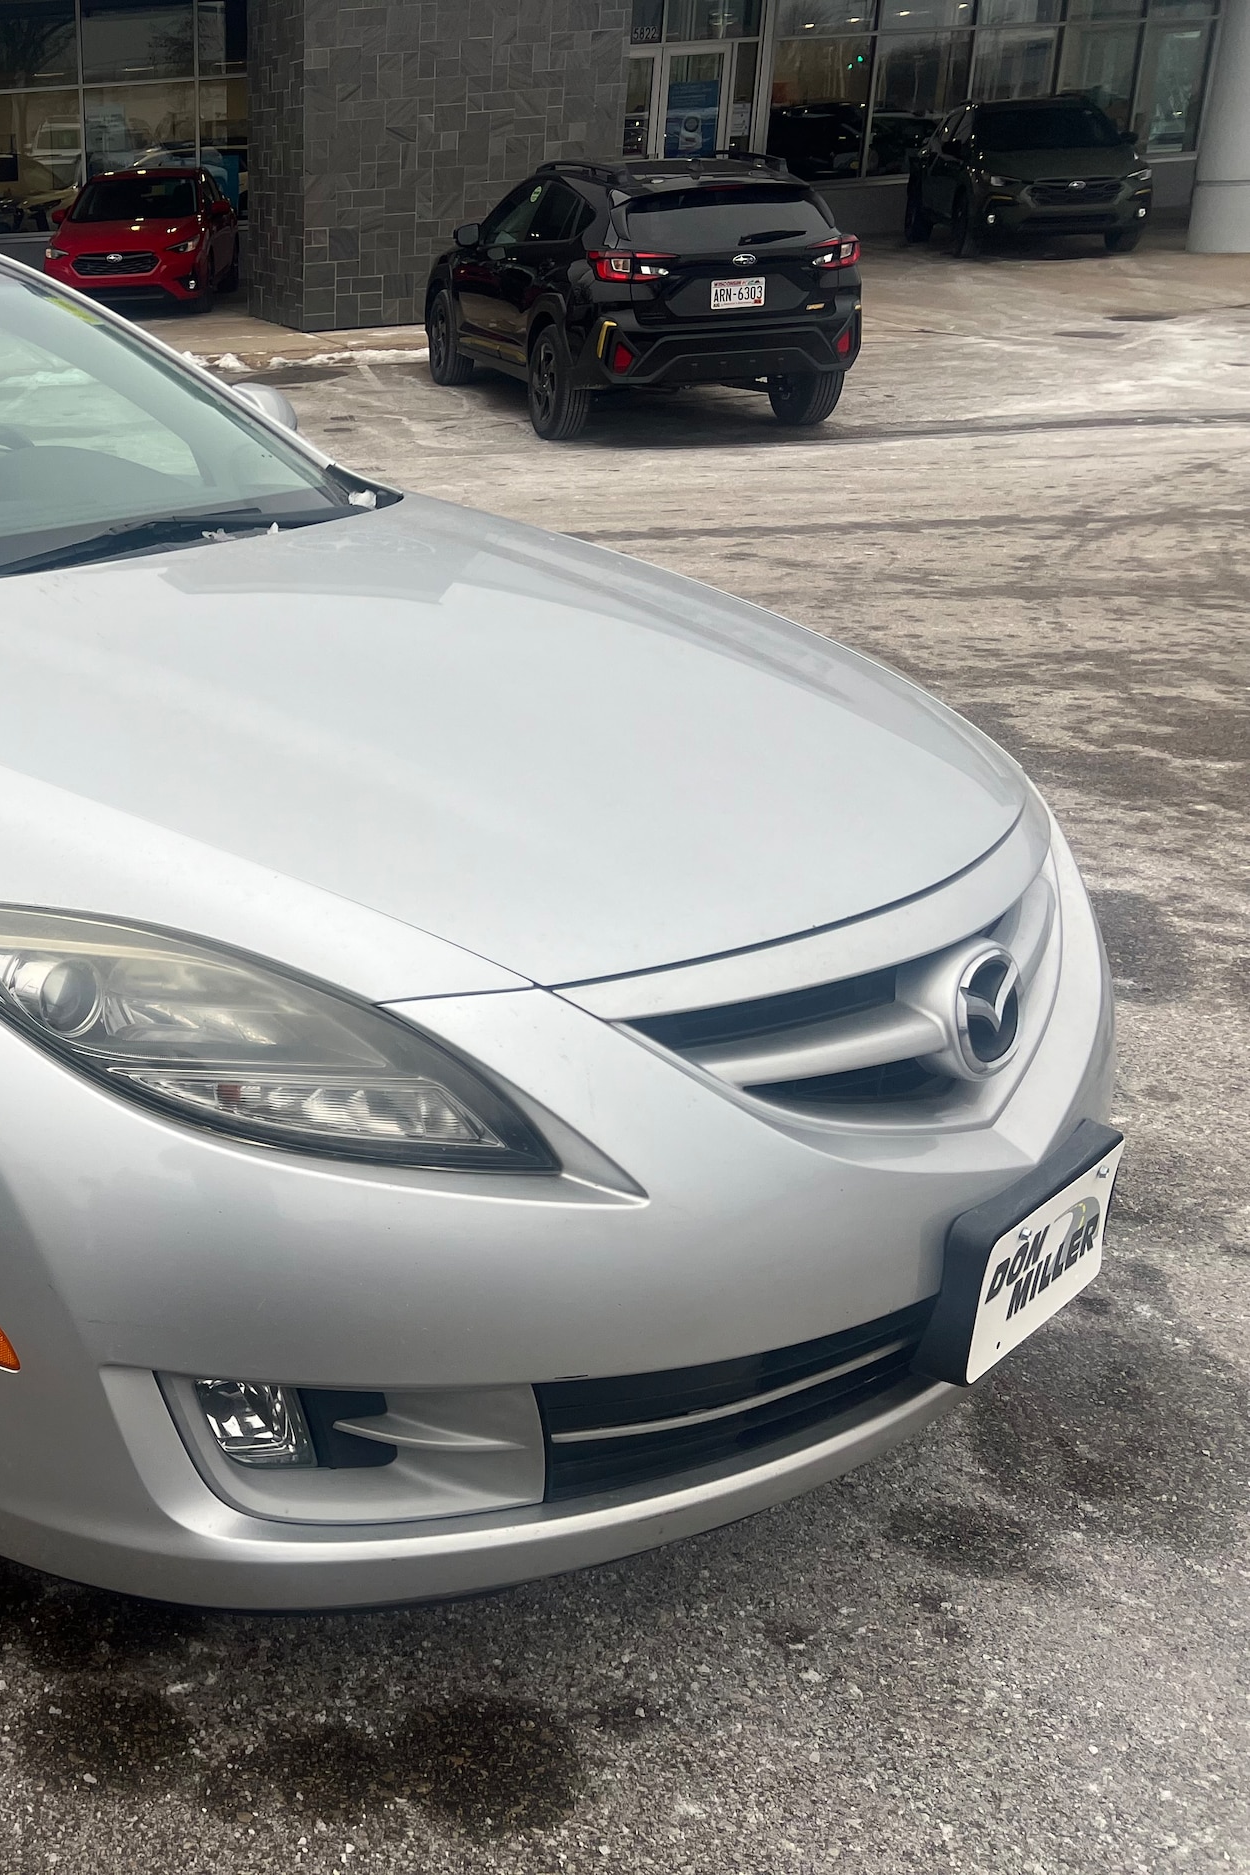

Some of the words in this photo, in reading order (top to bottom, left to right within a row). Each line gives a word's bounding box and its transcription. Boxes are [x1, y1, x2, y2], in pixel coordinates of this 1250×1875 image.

[633, 27, 657, 40] 5822
[714, 286, 762, 302] ARN-6303
[984, 1223, 1050, 1304] DON
[1005, 1213, 1100, 1321] MILLER
